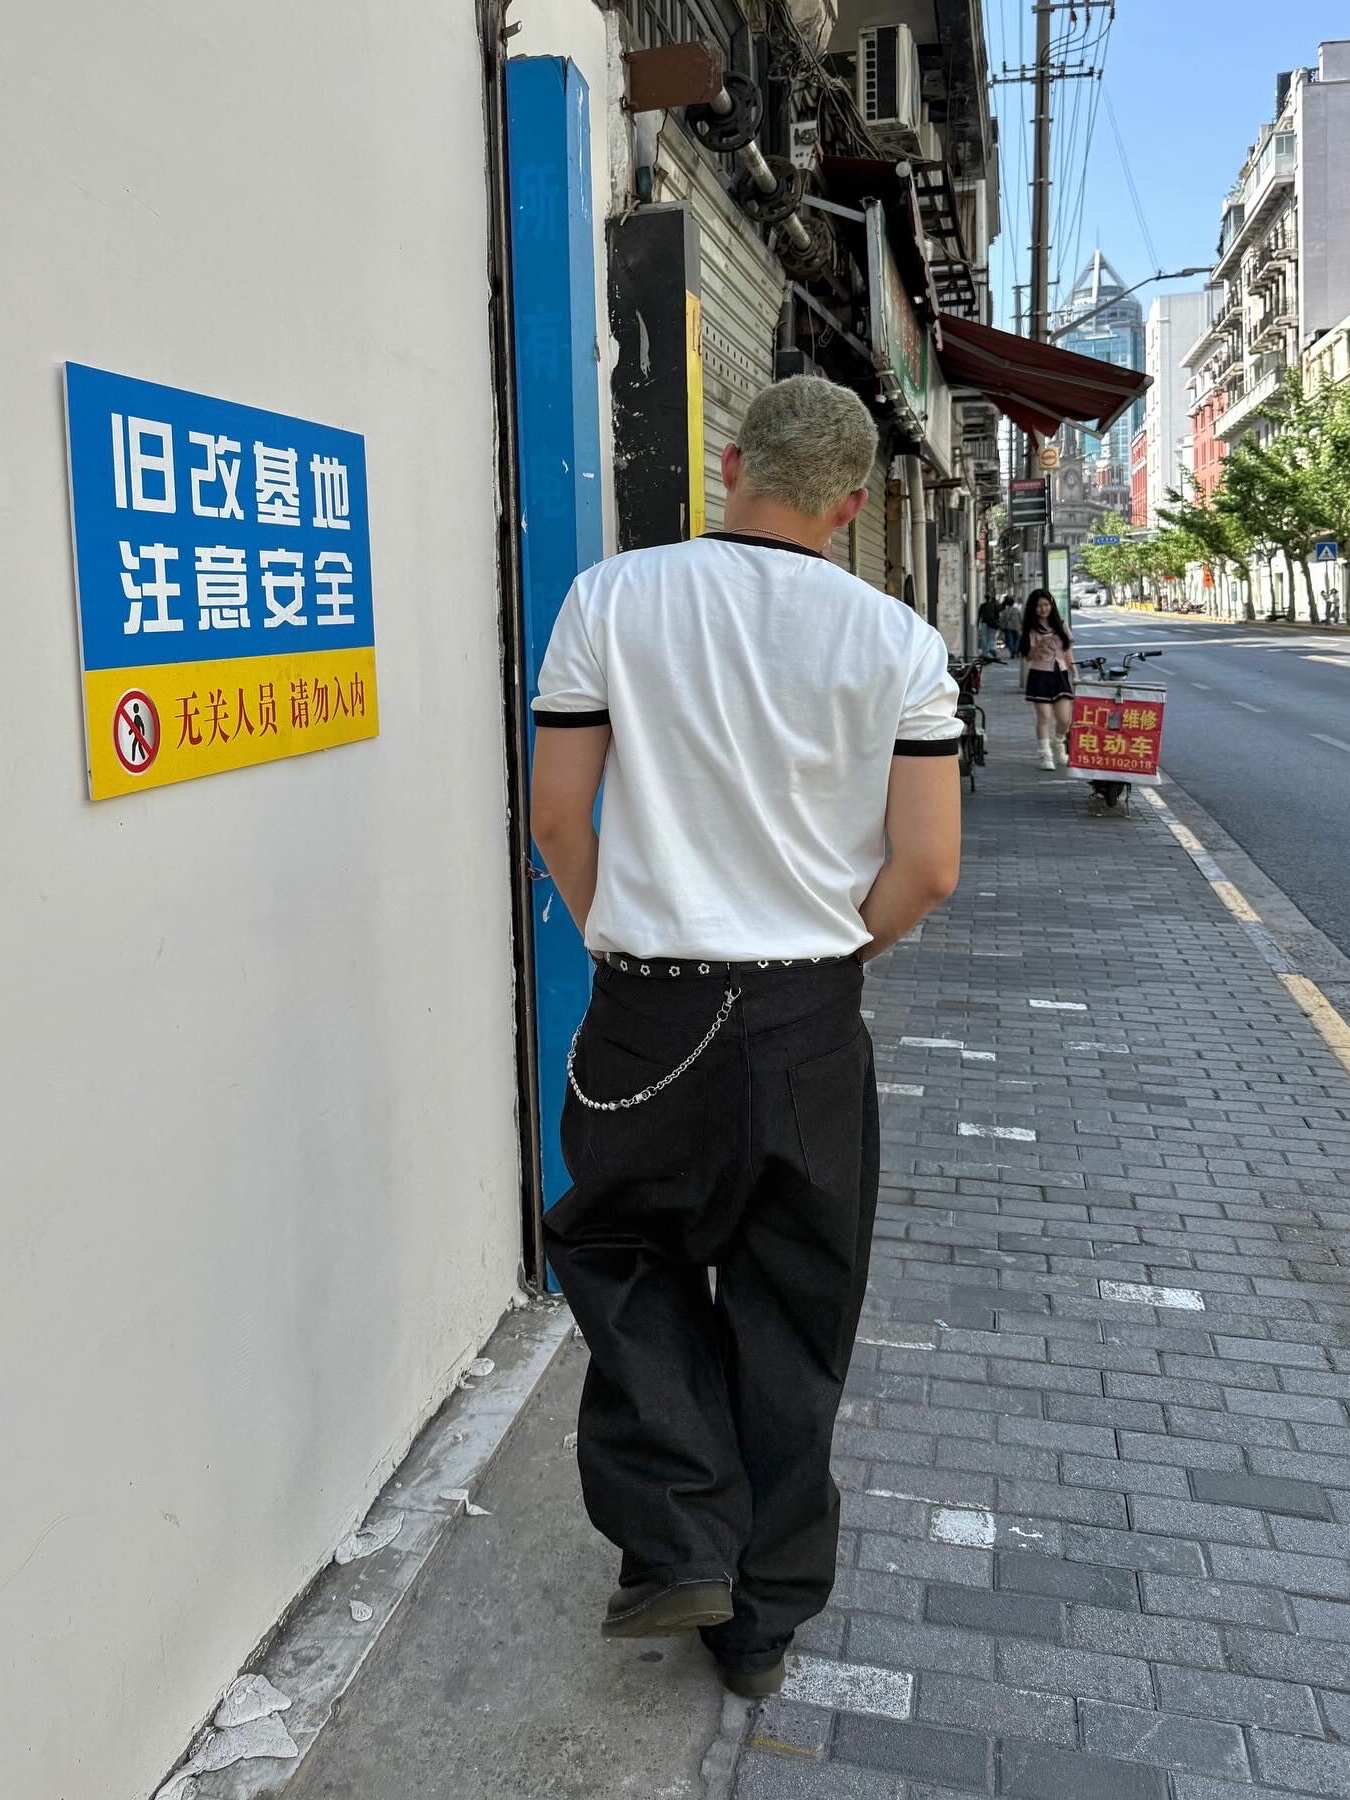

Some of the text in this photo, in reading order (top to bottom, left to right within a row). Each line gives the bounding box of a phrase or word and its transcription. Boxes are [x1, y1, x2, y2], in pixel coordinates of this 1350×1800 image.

[111, 412, 351, 530] 旧改基地
[118, 540, 355, 635] 注意安全
[174, 671, 366, 749] 无关人员 请勿入内
[1078, 732, 1153, 758] 电动车
[1077, 755, 1152, 769] 15121102018
